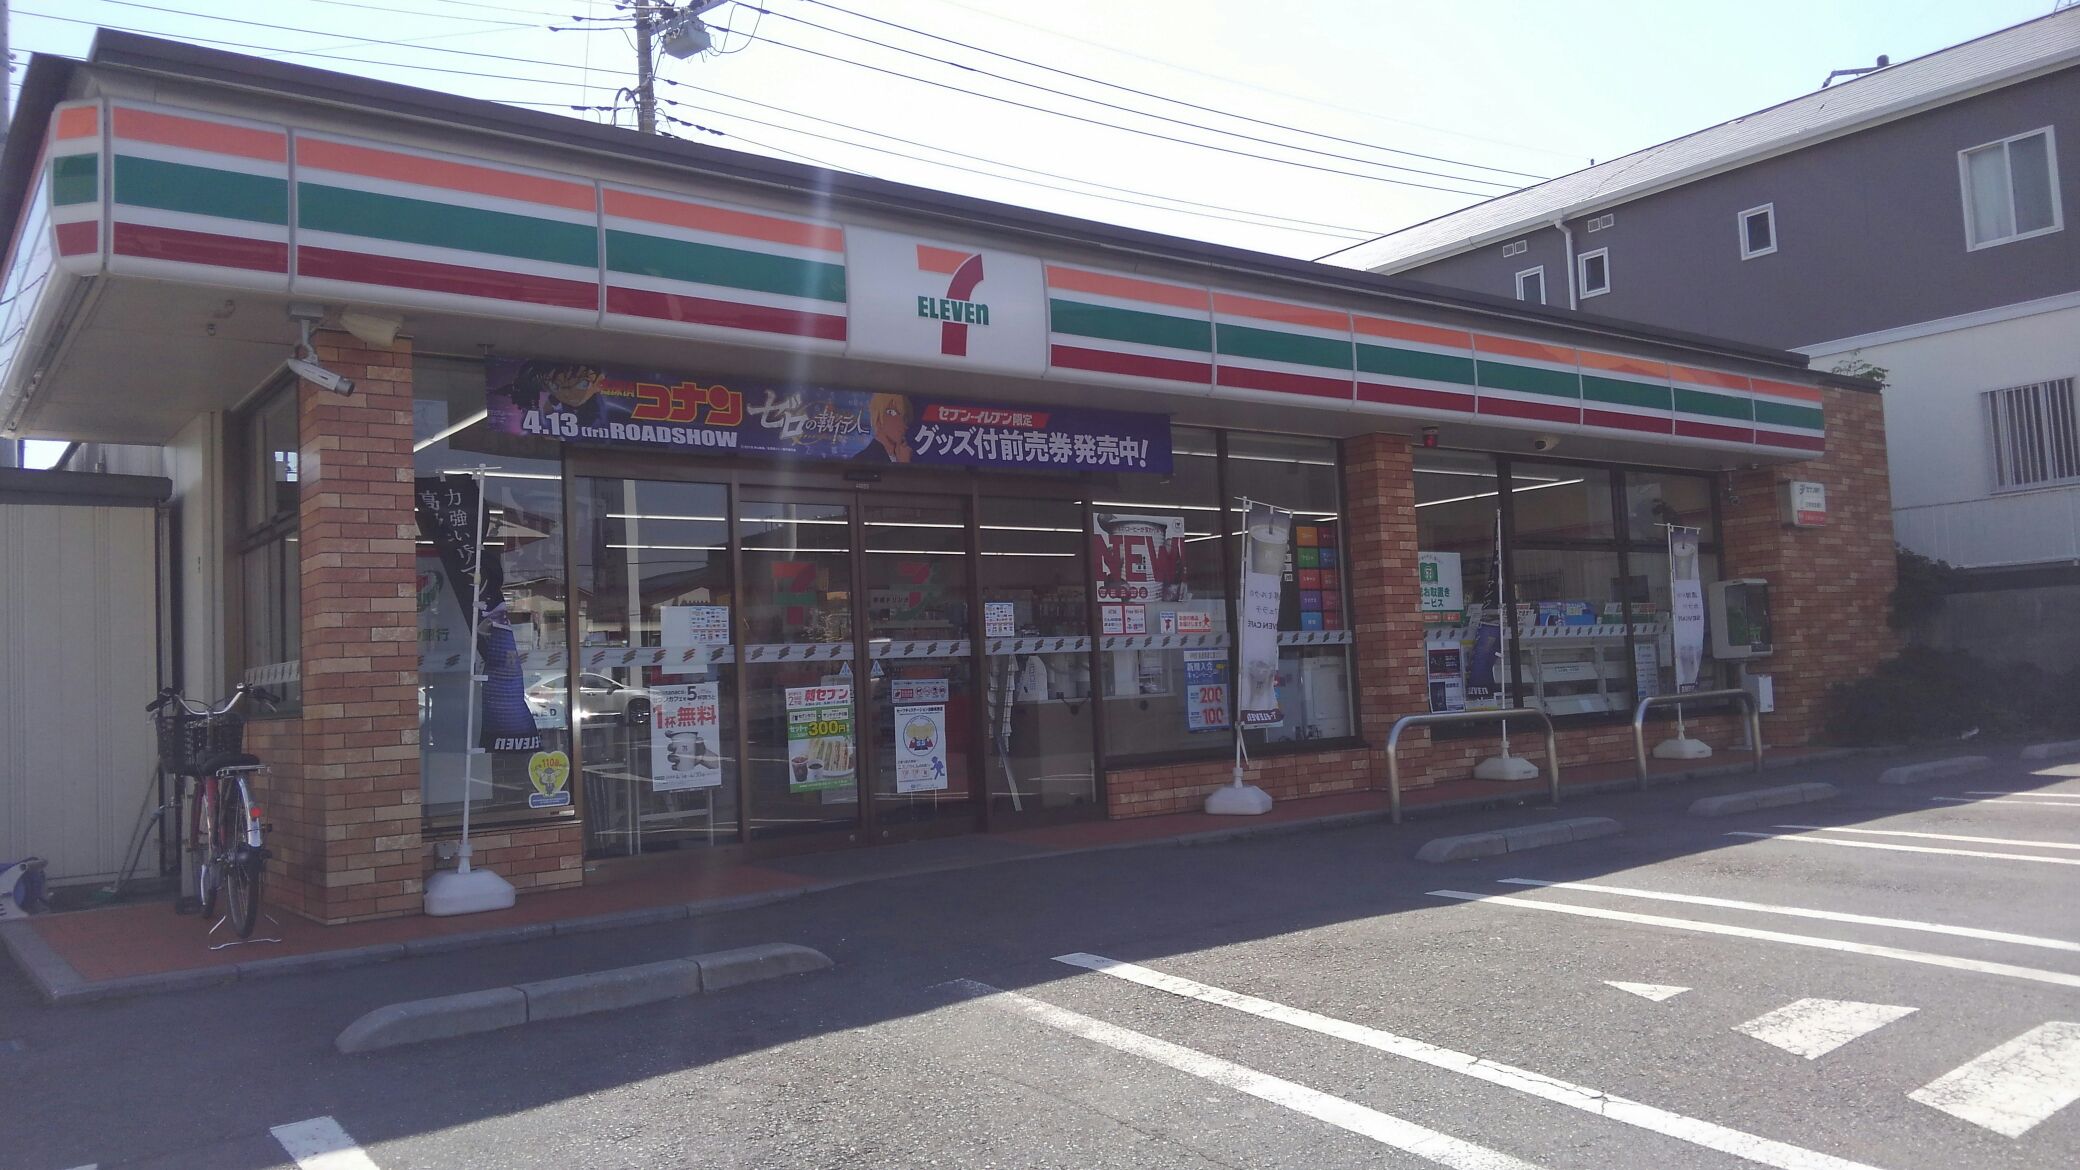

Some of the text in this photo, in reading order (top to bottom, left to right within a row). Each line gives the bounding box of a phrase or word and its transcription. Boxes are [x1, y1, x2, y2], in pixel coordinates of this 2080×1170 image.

[631, 382, 743, 427] コナン
[523, 410, 578, 437] 4.13
[610, 422, 738, 449] ROADSHOW
